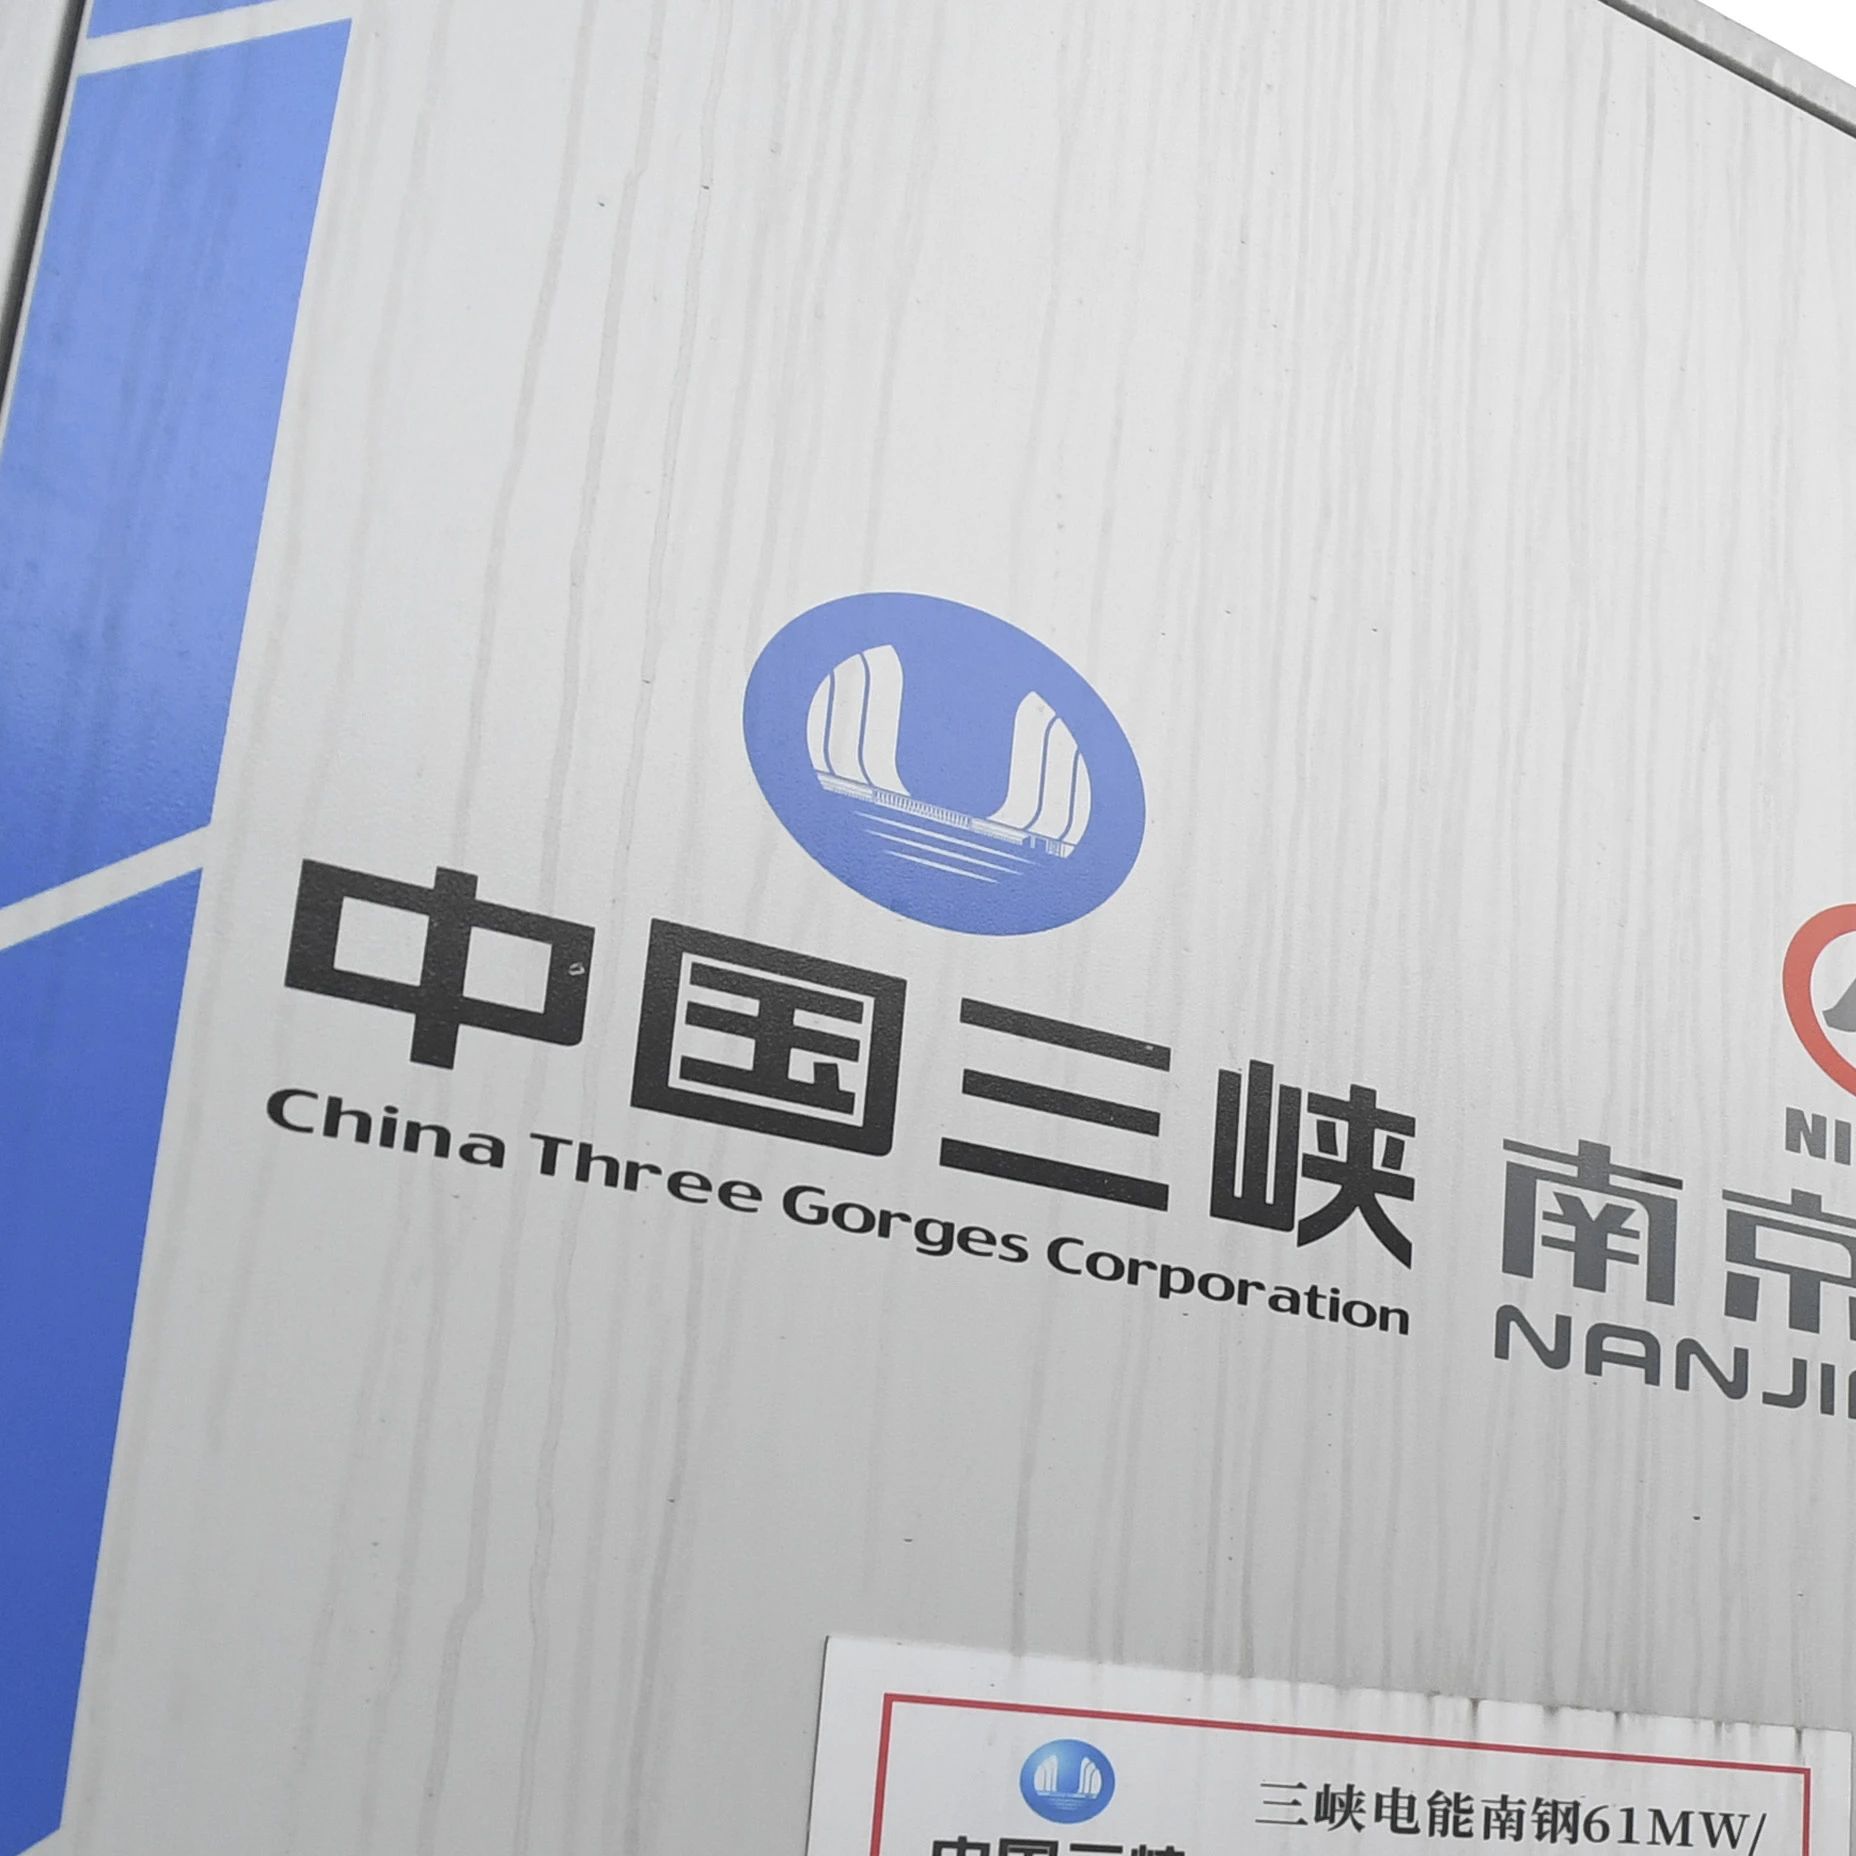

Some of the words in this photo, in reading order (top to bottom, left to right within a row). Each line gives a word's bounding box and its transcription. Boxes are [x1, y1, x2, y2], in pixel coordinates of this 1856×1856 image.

[266, 1087, 506, 1169] China
[529, 1132, 763, 1213] Three
[782, 1185, 1029, 1263] Gorges
[1047, 1236, 1410, 1337] Corporation
[284, 857, 1416, 1270] 中国三峡
